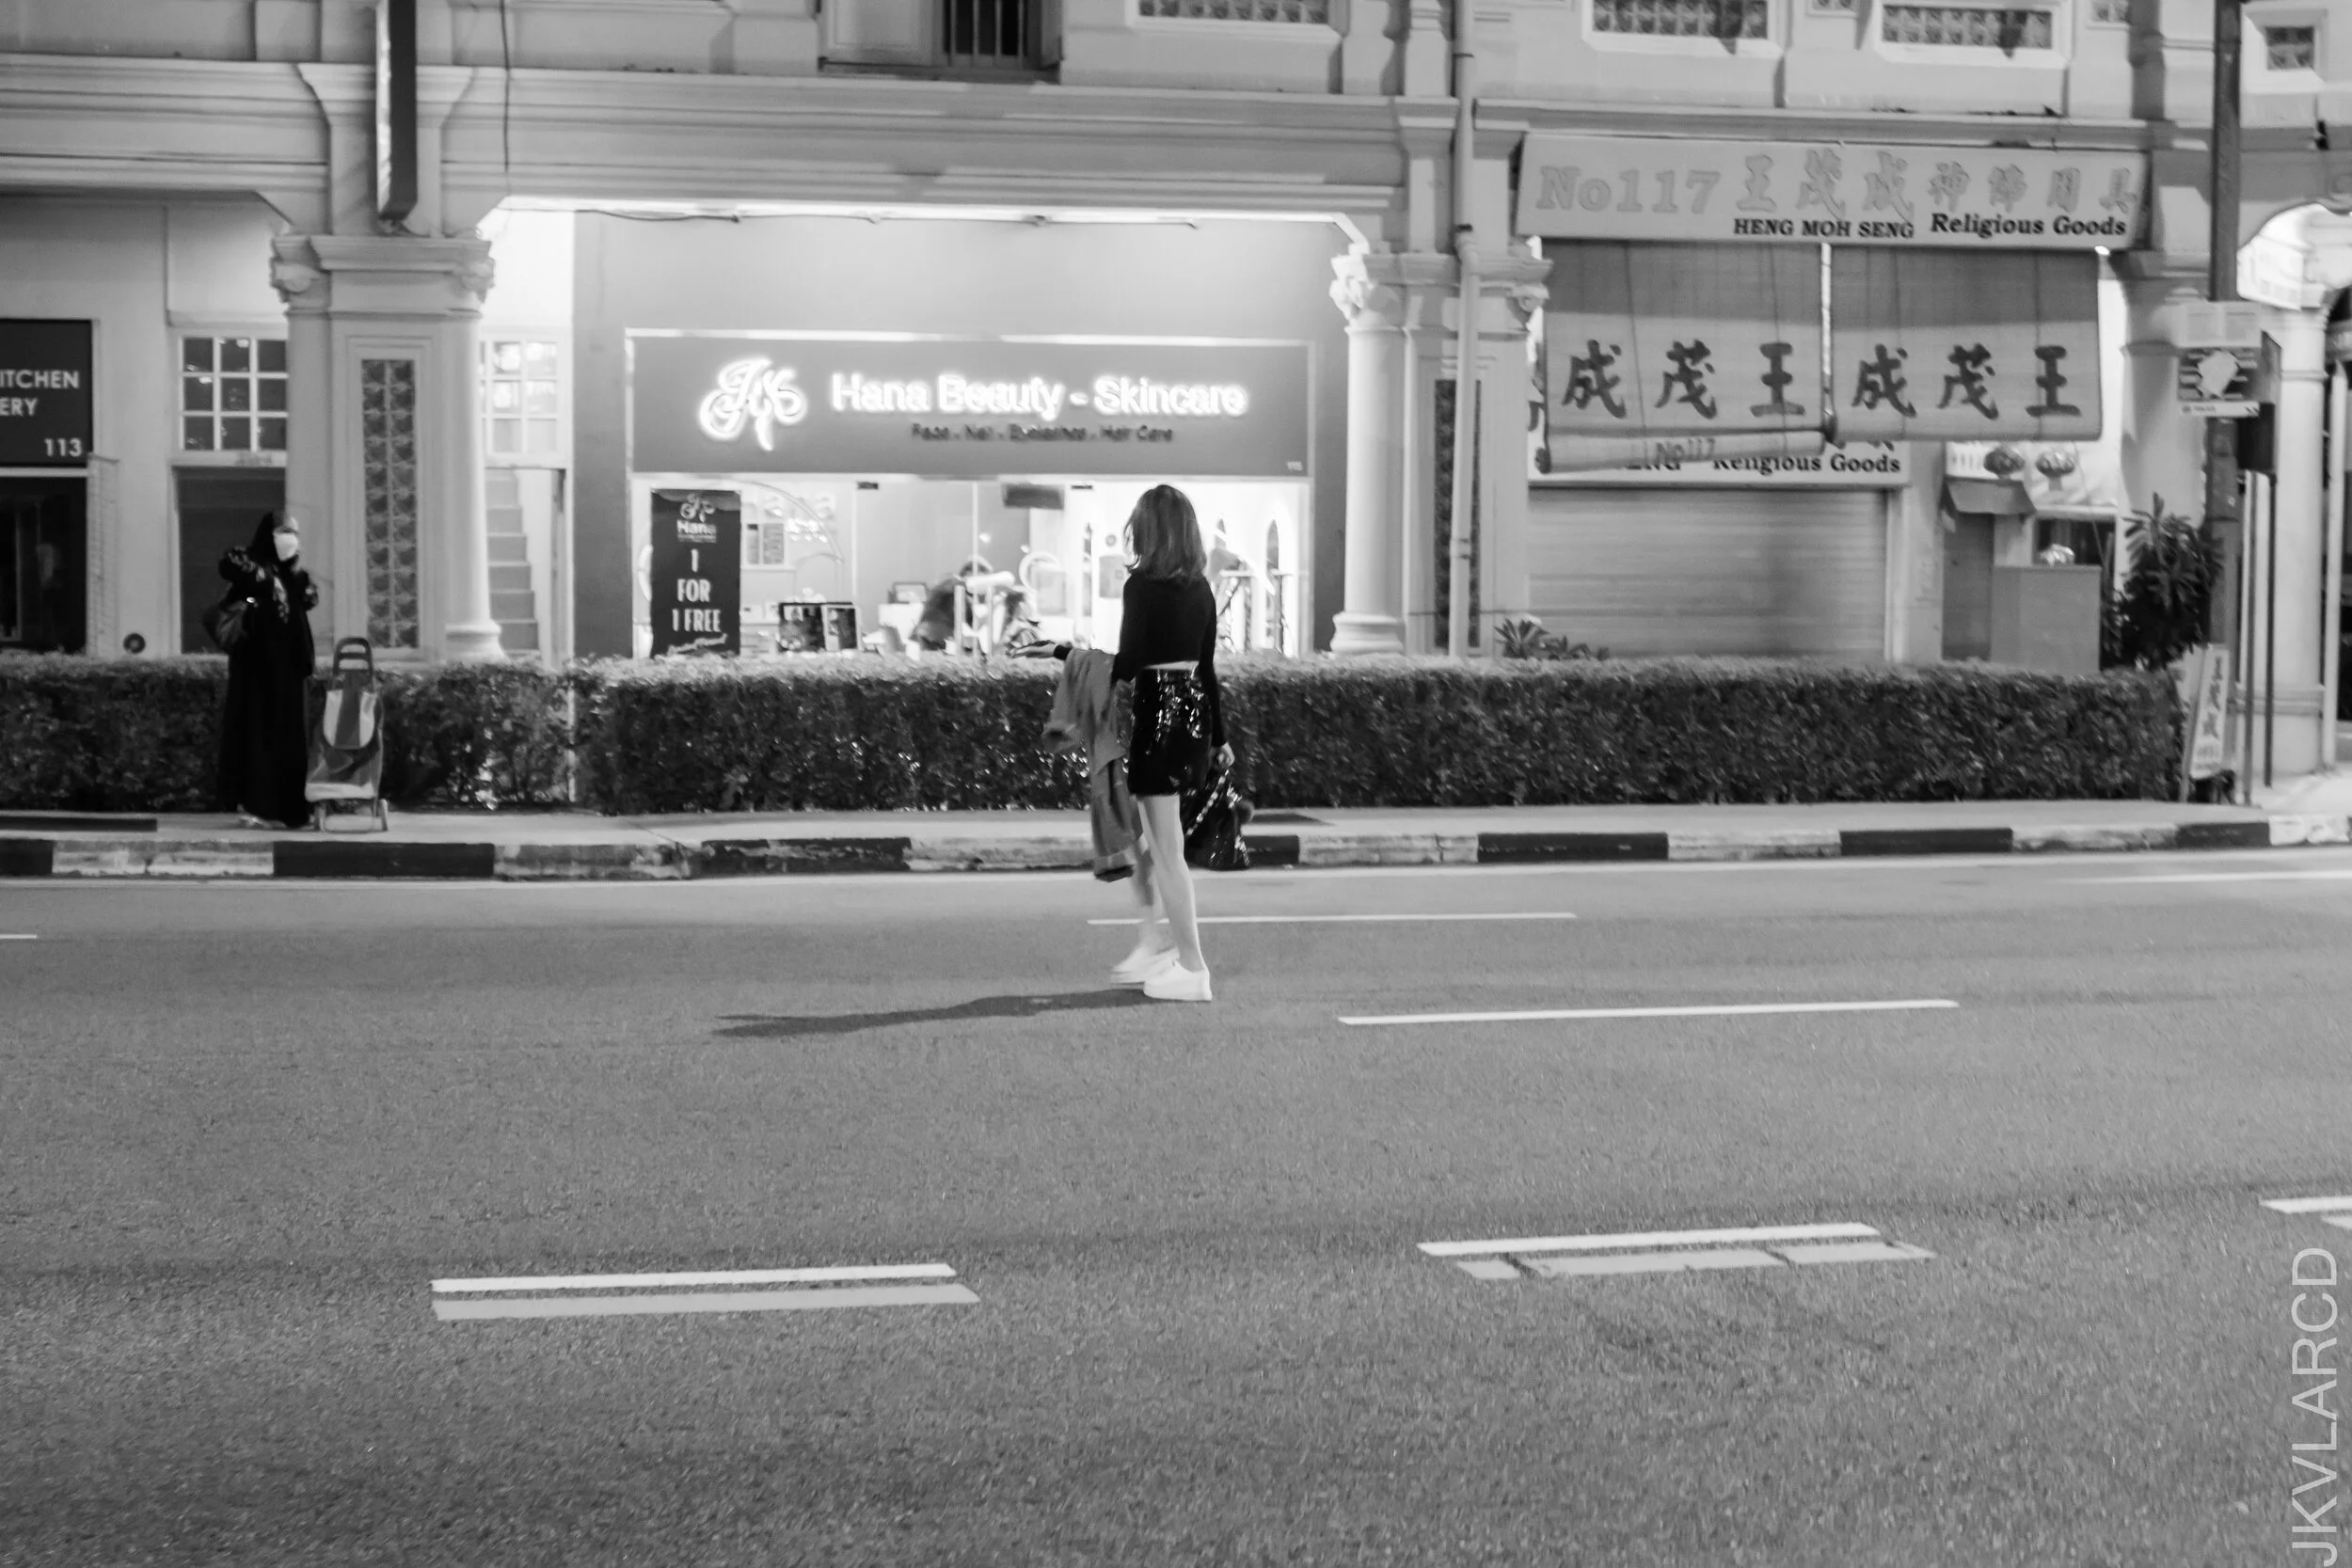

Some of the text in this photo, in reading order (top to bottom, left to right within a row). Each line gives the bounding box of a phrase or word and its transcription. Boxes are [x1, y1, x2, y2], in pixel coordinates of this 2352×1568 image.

[1534, 165, 1721, 214] No117
[1733, 217, 1914, 238] HENG MOH SENG
[1931, 213, 2126, 239] Religious Goods
[0, 369, 79, 388] ITCHEN
[0, 397, 38, 416] ERY
[831, 372, 932, 412] Hana
[938, 373, 1065, 420] Beauty
[1093, 374, 1248, 416] Skincare
[44, 436, 82, 457] 113
[1830, 452, 1900, 472] Goods
[677, 578, 710, 602] FOR
[684, 609, 721, 632] FREE
